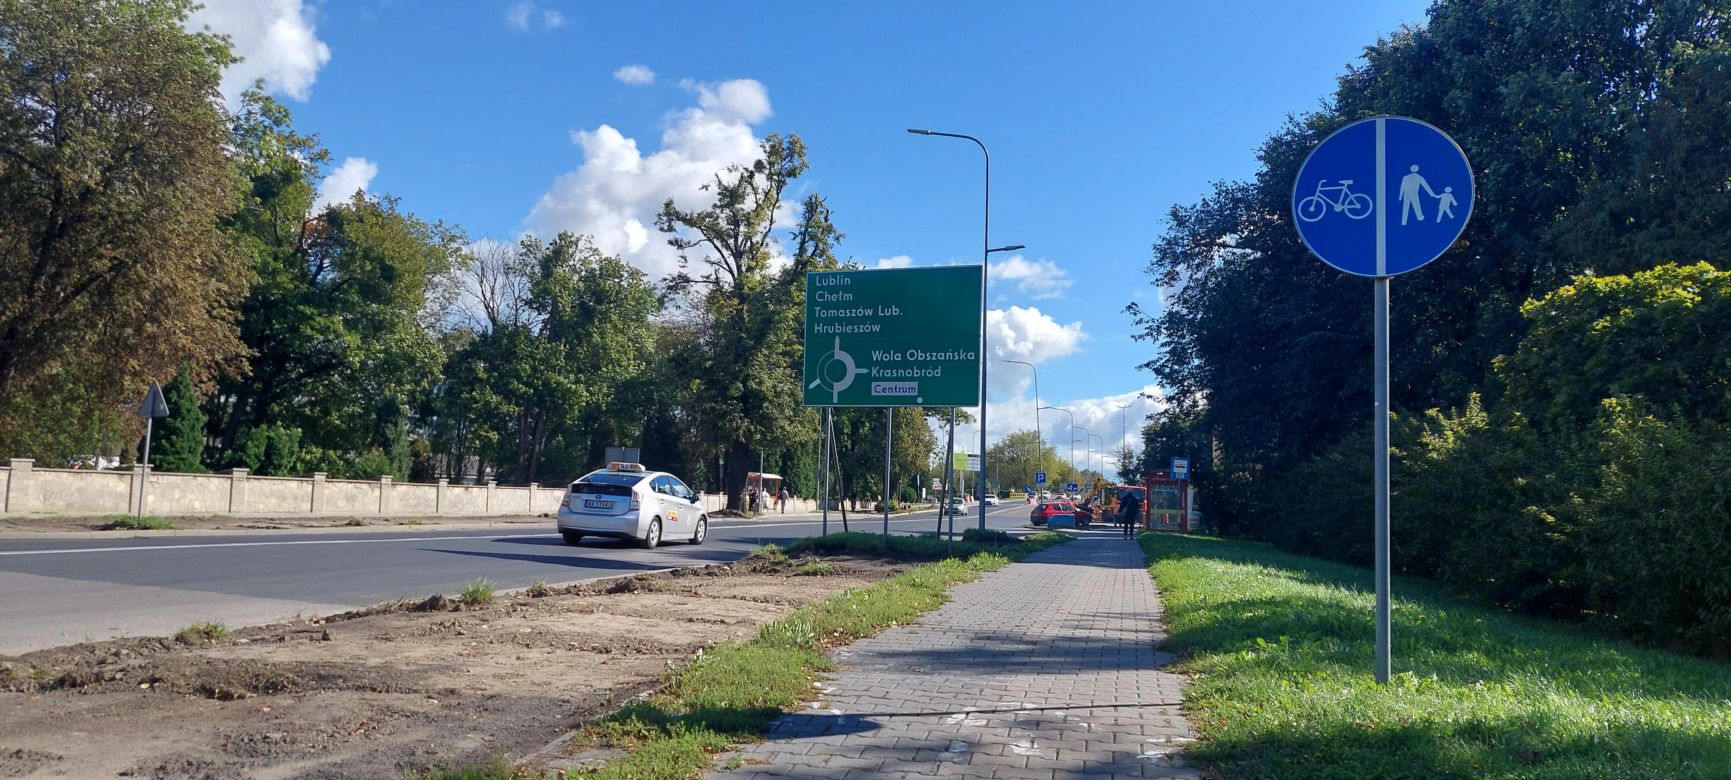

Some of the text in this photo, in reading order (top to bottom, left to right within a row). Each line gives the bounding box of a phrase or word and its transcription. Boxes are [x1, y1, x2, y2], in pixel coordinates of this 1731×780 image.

[816, 275, 851, 286] Lublin
[816, 290, 853, 302] Chełm
[814, 305, 903, 317] Tomaszów Lub.
[814, 321, 880, 334] Hrubieszów
[872, 349, 975, 362] Wola Obszańska
[871, 365, 941, 377] Krasnobród
[874, 384, 916, 394] Centrum
[1037, 473, 1044, 482] P
